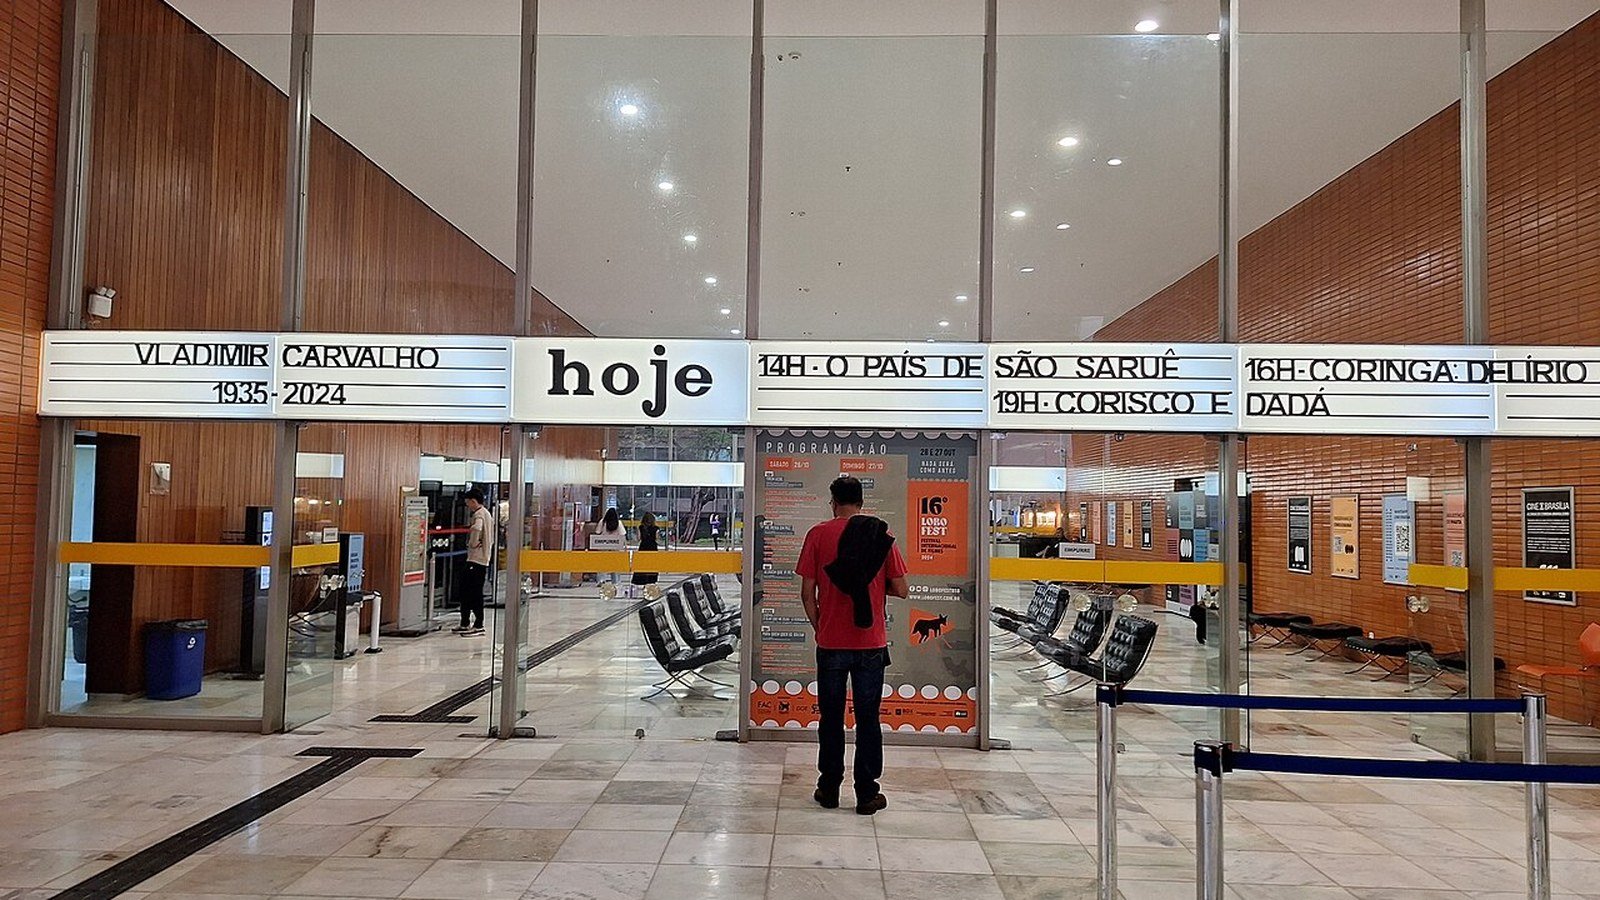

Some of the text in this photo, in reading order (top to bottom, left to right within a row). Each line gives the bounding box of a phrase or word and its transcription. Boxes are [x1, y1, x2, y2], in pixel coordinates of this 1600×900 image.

[135, 343, 439, 369] VLADIMIR CARVALHO
[826, 355, 848, 377] O
[864, 350, 927, 377] PAÍS
[944, 355, 983, 378] DE
[995, 350, 1057, 379] SÃO
[1076, 348, 1181, 379] SARUÊ
[1466, 354, 1587, 384] DELÍRIO
[547, 345, 713, 418] hoje
[1212, 391, 1231, 415] E
[1246, 387, 1331, 416] DADÁ
[765, 441, 888, 456] PROGRAMAÇÃO
[921, 517, 948, 527] LOBO
[921, 526, 948, 536] FEST
